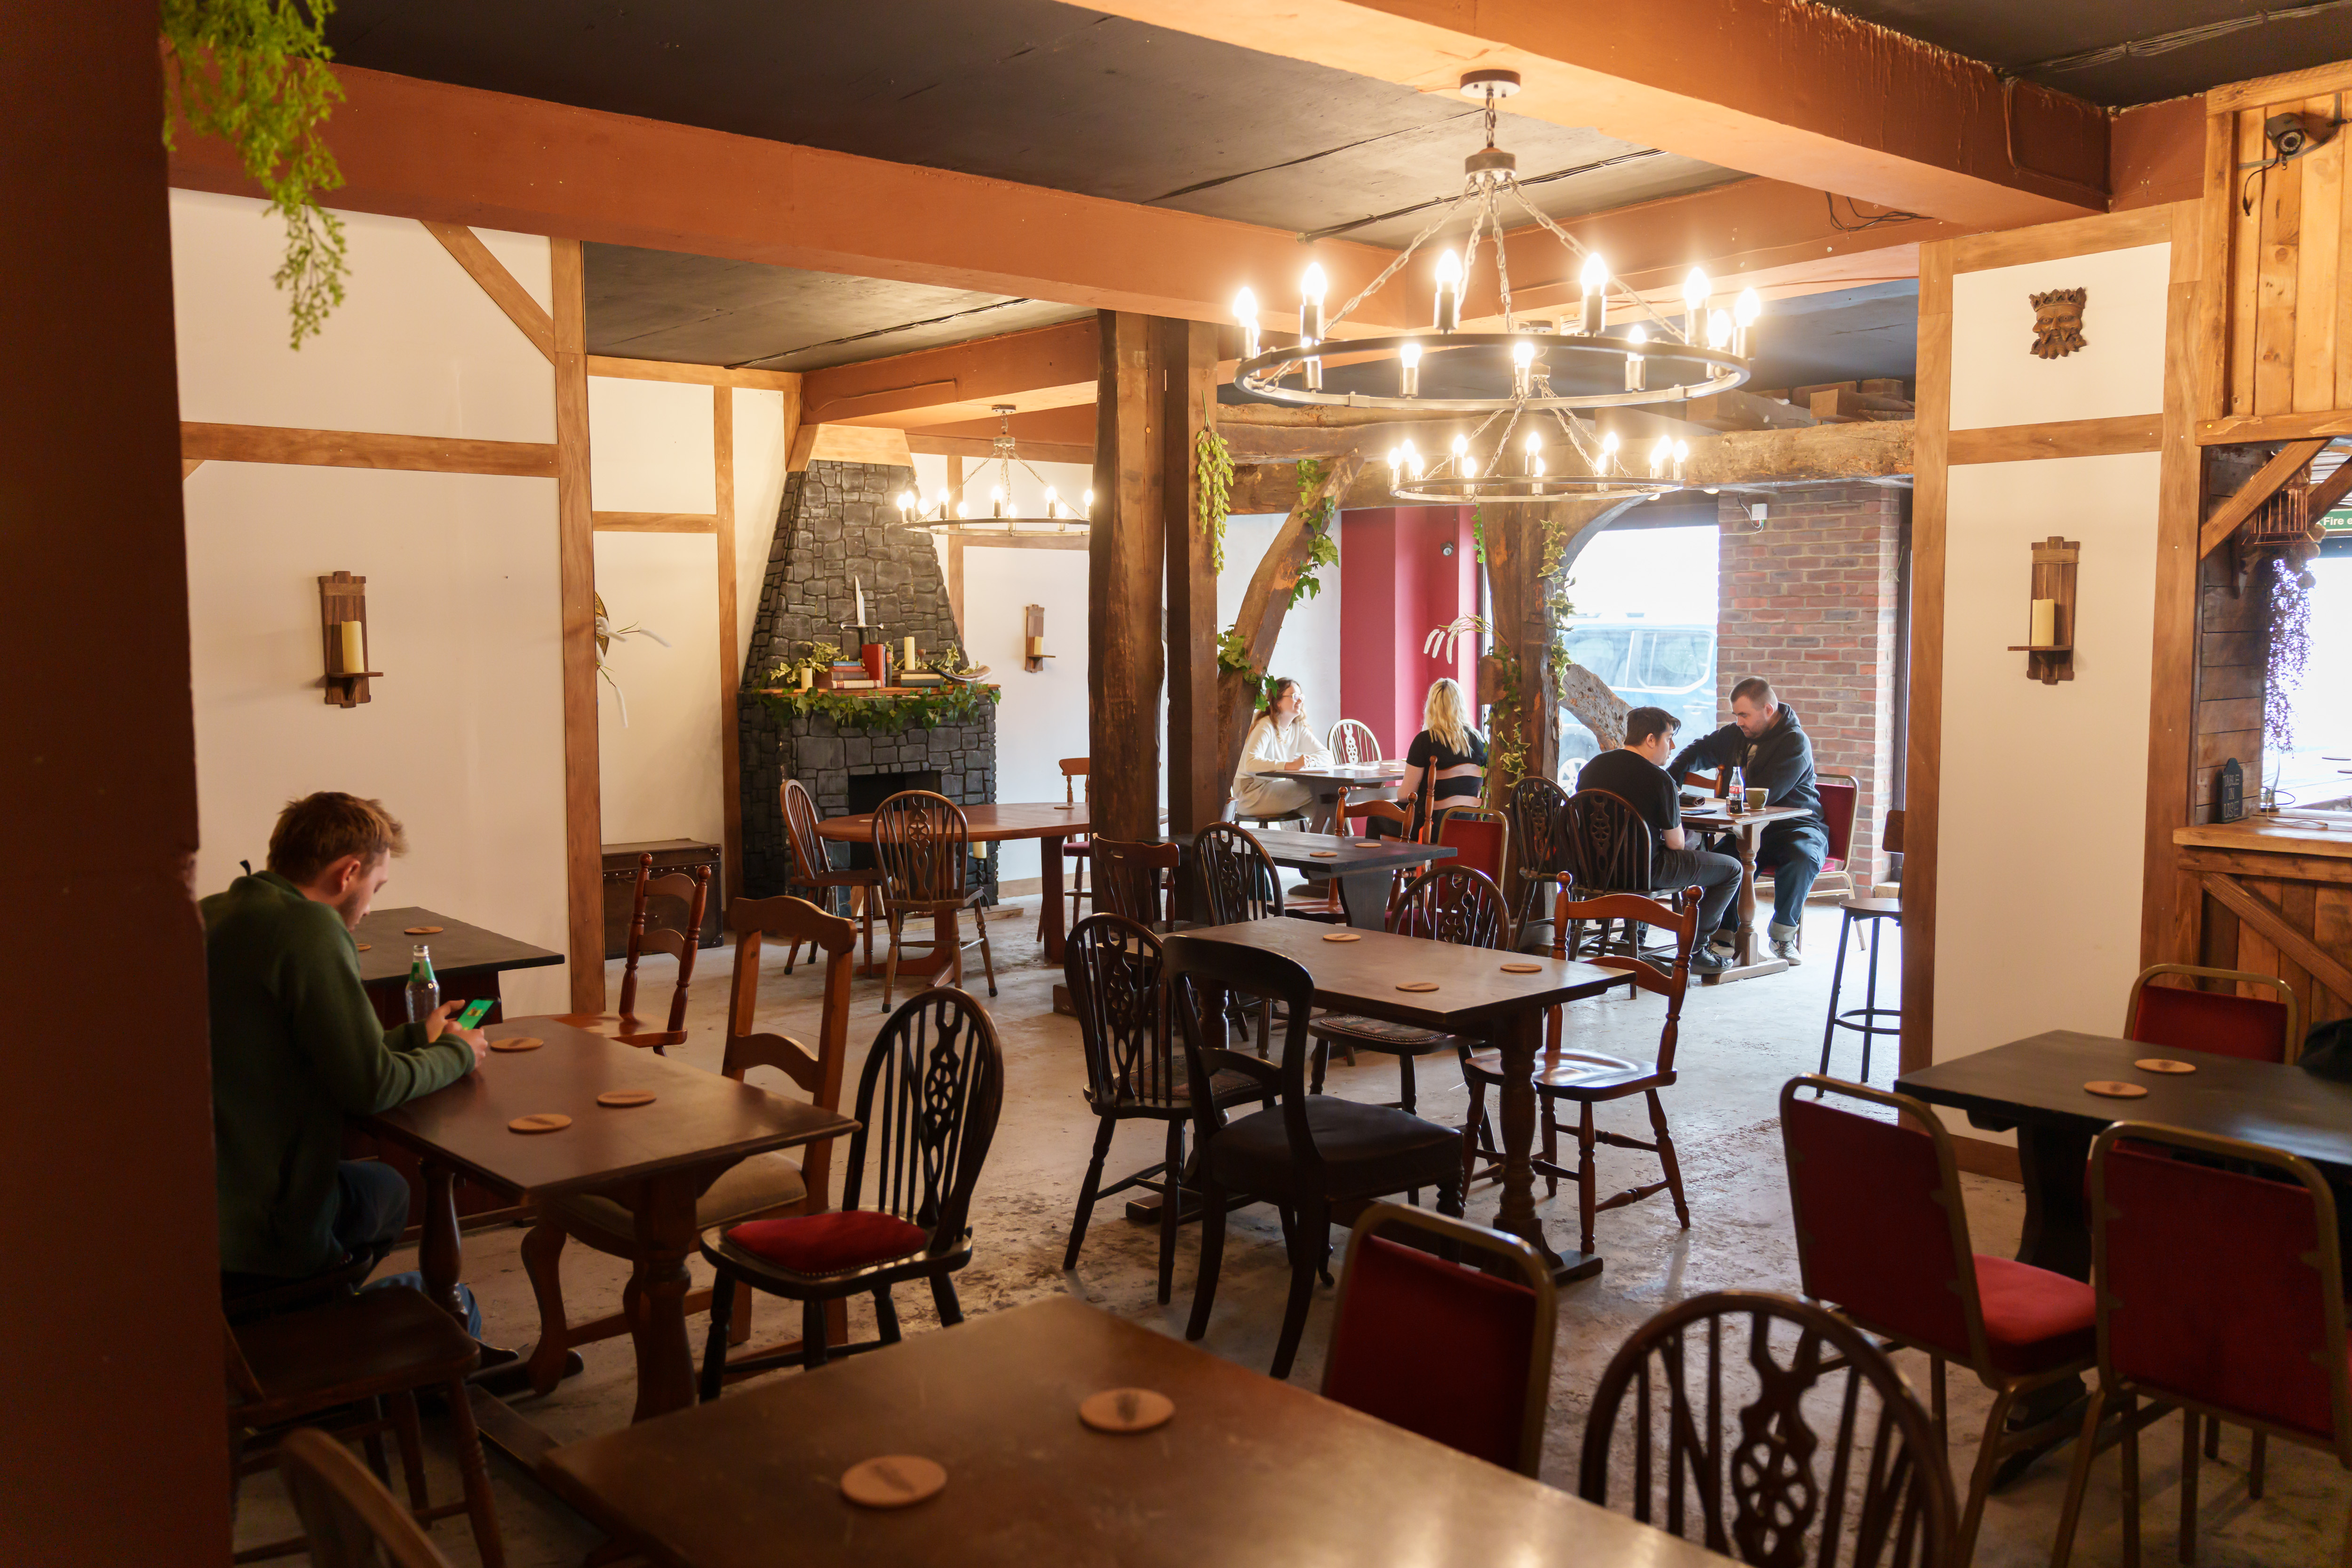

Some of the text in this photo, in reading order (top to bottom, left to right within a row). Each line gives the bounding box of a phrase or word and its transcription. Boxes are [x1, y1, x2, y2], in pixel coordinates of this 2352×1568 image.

[2323, 517, 2344, 525] Fire
[2223, 774, 2239, 787] TABLE
[2228, 788, 2235, 800] IN
[2224, 801, 2239, 818] USE
